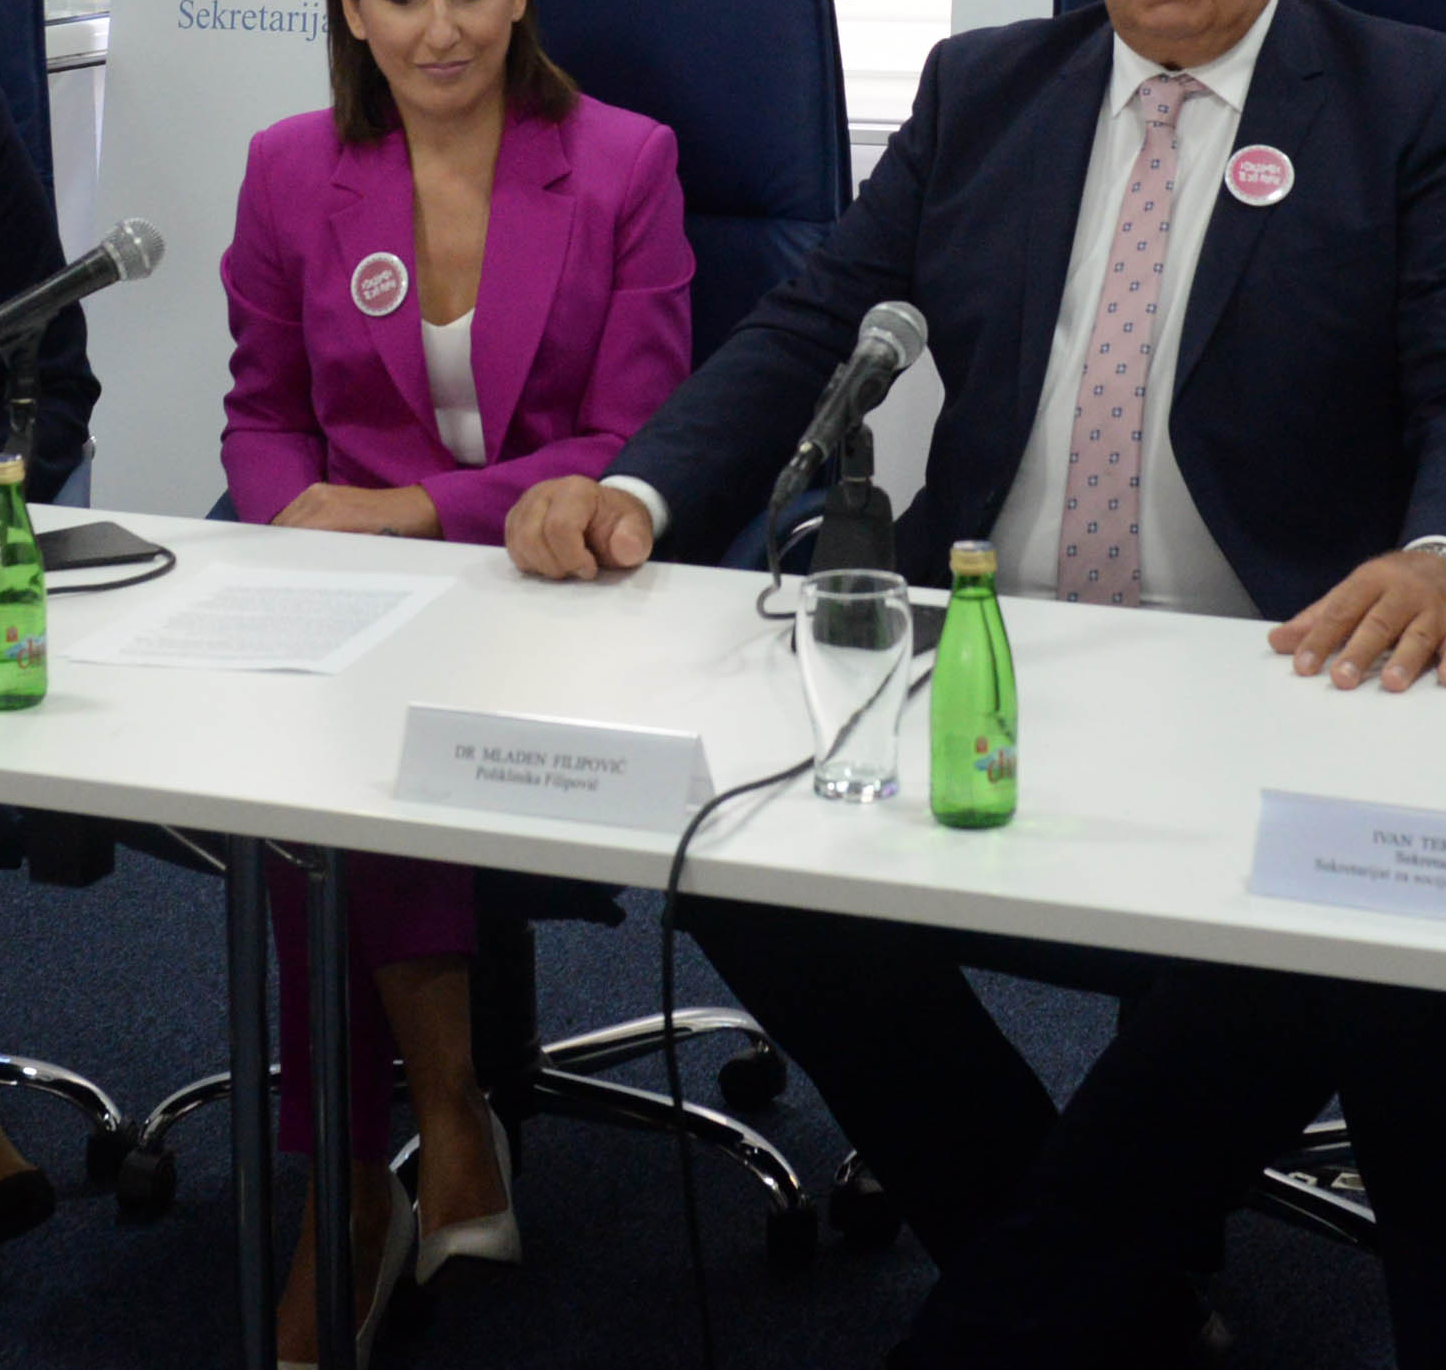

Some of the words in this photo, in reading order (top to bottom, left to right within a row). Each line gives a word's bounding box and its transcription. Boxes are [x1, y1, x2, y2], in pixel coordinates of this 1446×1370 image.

[454, 744, 475, 760] DR
[482, 746, 547, 767] MLADEN
[552, 751, 629, 776] FILIPOVIĆ
[1373, 829, 1413, 848] IVAN
